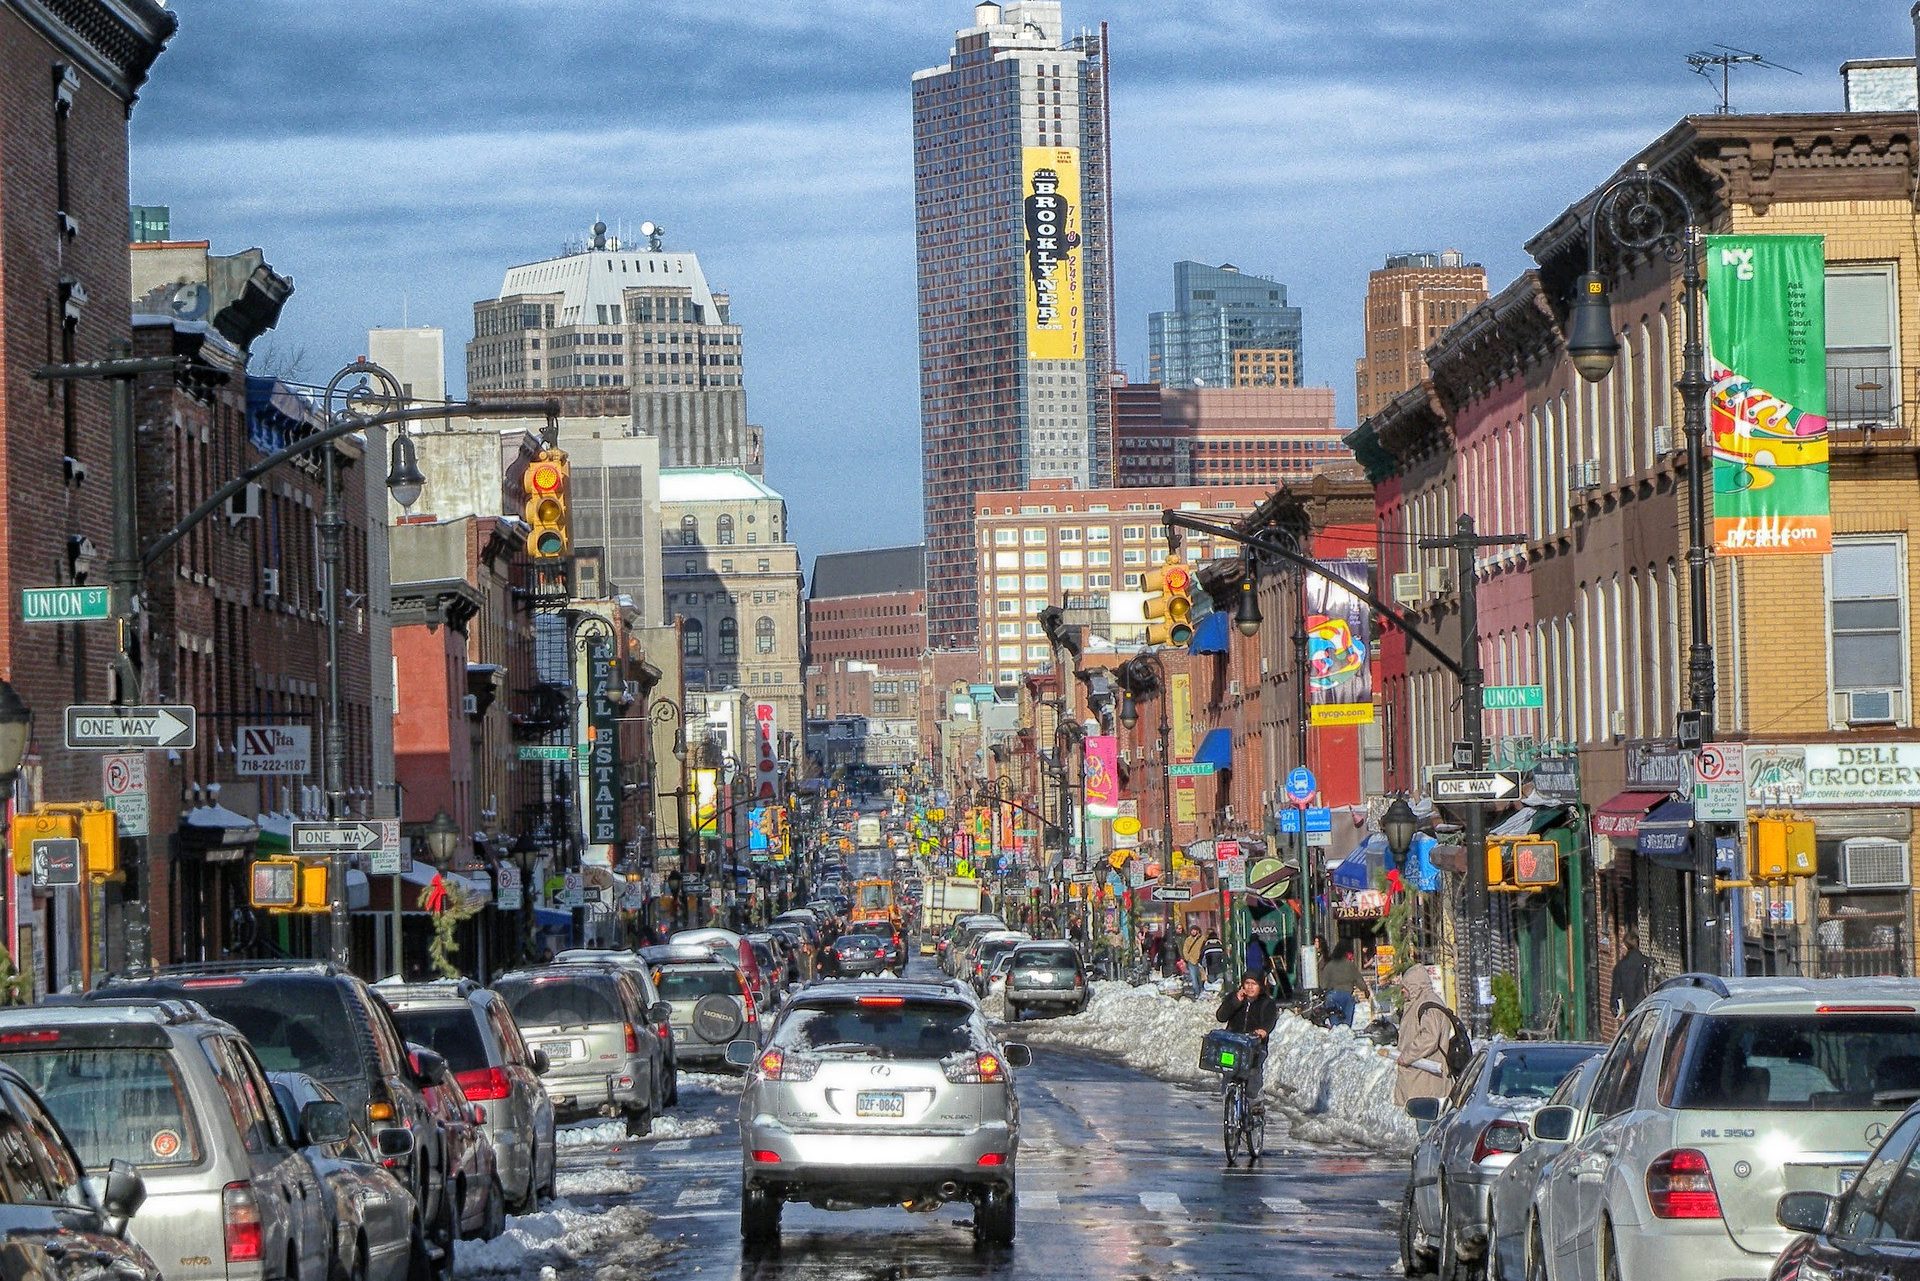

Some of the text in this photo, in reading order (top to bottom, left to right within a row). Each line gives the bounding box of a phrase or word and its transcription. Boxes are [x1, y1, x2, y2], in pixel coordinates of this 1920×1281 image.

[1035, 182, 1060, 318] BROOKLYNER
[1787, 310, 1804, 318] City
[1787, 319, 1812, 327] about
[28, 590, 102, 617] UNION ST
[1488, 688, 1540, 706] UNION ST
[1318, 709, 1366, 720] nycgo.com
[81, 718, 156, 737] ONE WAY
[593, 645, 615, 839] REAL ESTATE
[520, 748, 560, 758] SACKETT
[1838, 747, 1899, 765] DELI
[242, 760, 306, 771] 718-222-1187
[1171, 765, 1206, 775] SACKETT
[878, 768, 909, 776] OPTIL
[1441, 780, 1494, 793] ONE WAY
[1817, 790, 1840, 798] COFFEE
[1869, 789, 1903, 798] CATERING
[305, 831, 370, 843] ONE WAY
[1174, 889, 1187, 897] WAY
[1252, 926, 1278, 934] SAVOIA
[703, 1009, 735, 1023] HONDA
[1701, 1129, 1755, 1138] ML 350
